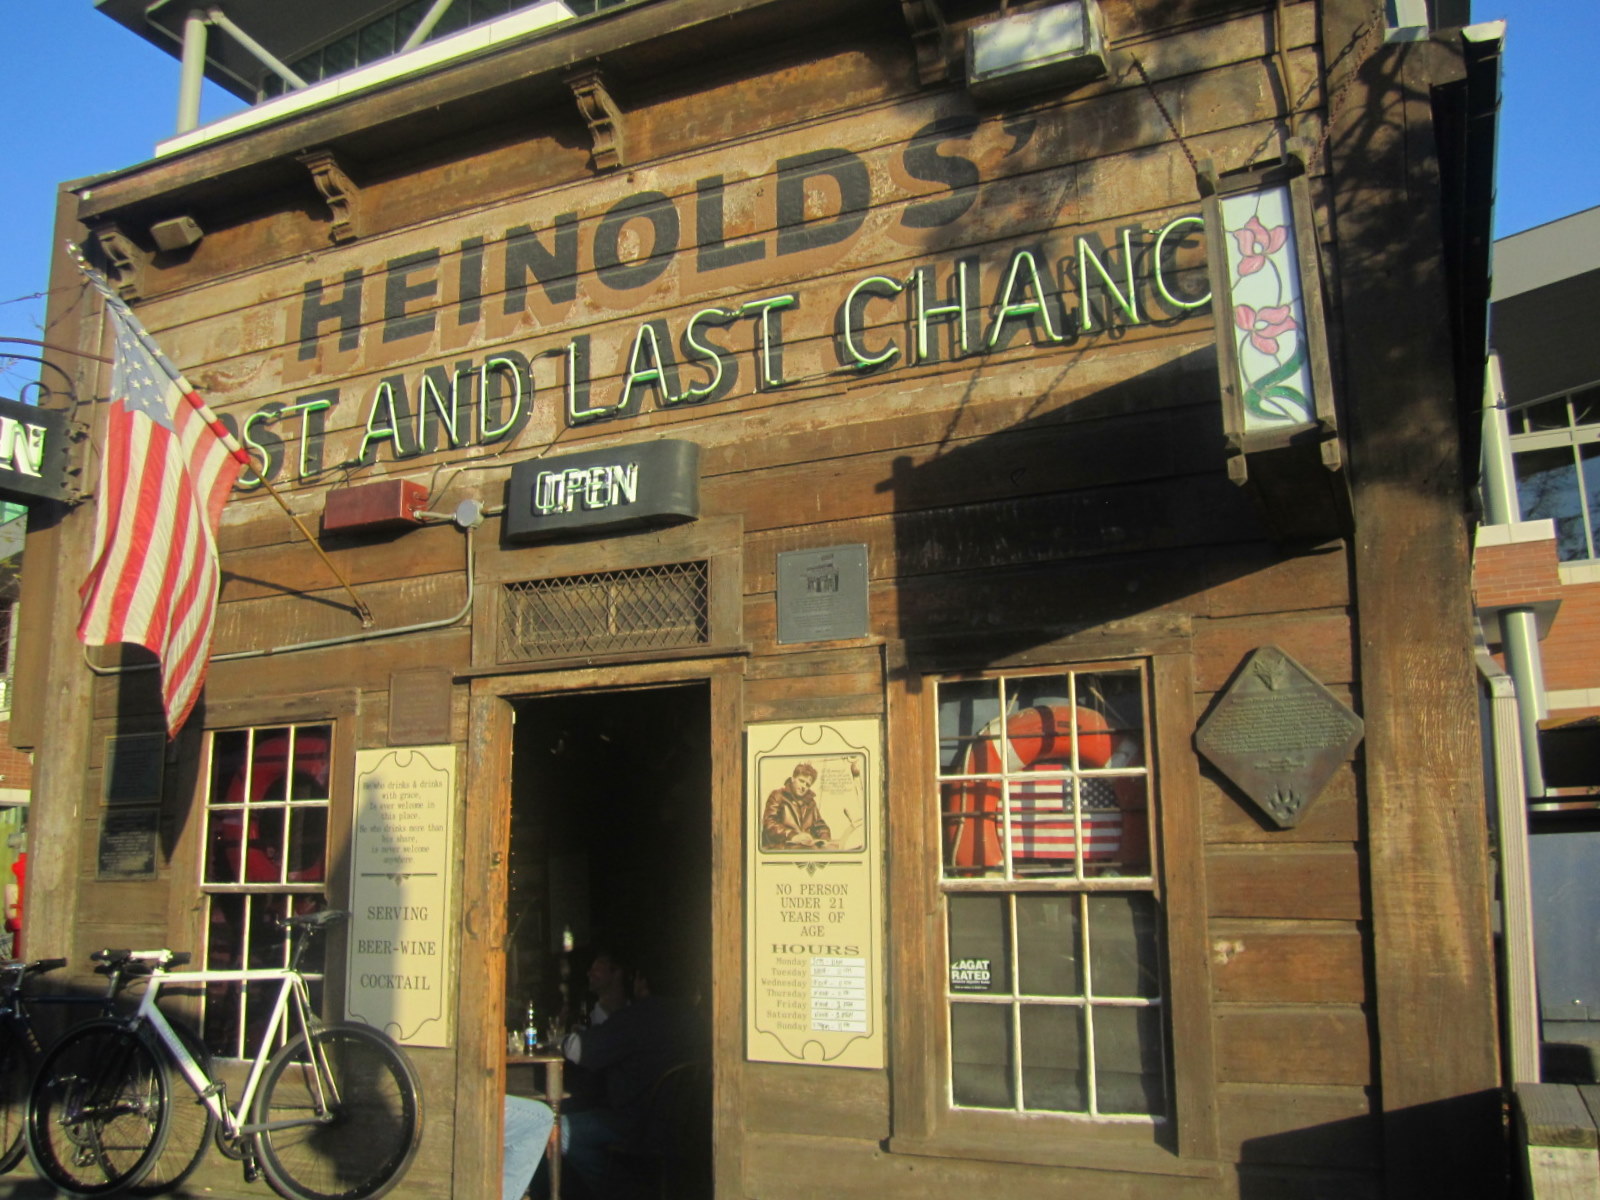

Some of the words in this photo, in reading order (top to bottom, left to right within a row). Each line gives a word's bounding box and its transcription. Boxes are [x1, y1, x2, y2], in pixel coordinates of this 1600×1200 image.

[357, 352, 536, 466] AND
[564, 292, 802, 426] LAST
[836, 214, 1213, 370] CHANC
[535, 462, 640, 515] OPEN
[387, 781, 409, 789] drinks
[420, 779, 442, 787] drinks
[383, 823, 406, 832] drinks
[427, 823, 443, 831] than
[403, 844, 429, 852] welcome
[775, 883, 791, 895] NO
[799, 883, 848, 895] PERSON
[780, 897, 820, 908] UNDER
[829, 897, 843, 908] 21
[366, 905, 429, 921] SERVING
[780, 911, 820, 922] YEARS
[828, 911, 845, 923] OF
[800, 925, 825, 937] AGE
[358, 939, 437, 956] BEER-WINE
[771, 943, 859, 955] HOURS
[776, 957, 806, 966] Monday
[951, 959, 989, 969] ZAGAT
[771, 968, 806, 977] Tuesday
[951, 970, 990, 980] RATED
[360, 973, 431, 991] COCKTAIL
[761, 978, 806, 988] Wednesday
[767, 989, 806, 998] Thursday
[776, 999, 806, 1008] Friday
[767, 1010, 806, 1019] Saturday
[776, 1021, 806, 1031] Sunday
